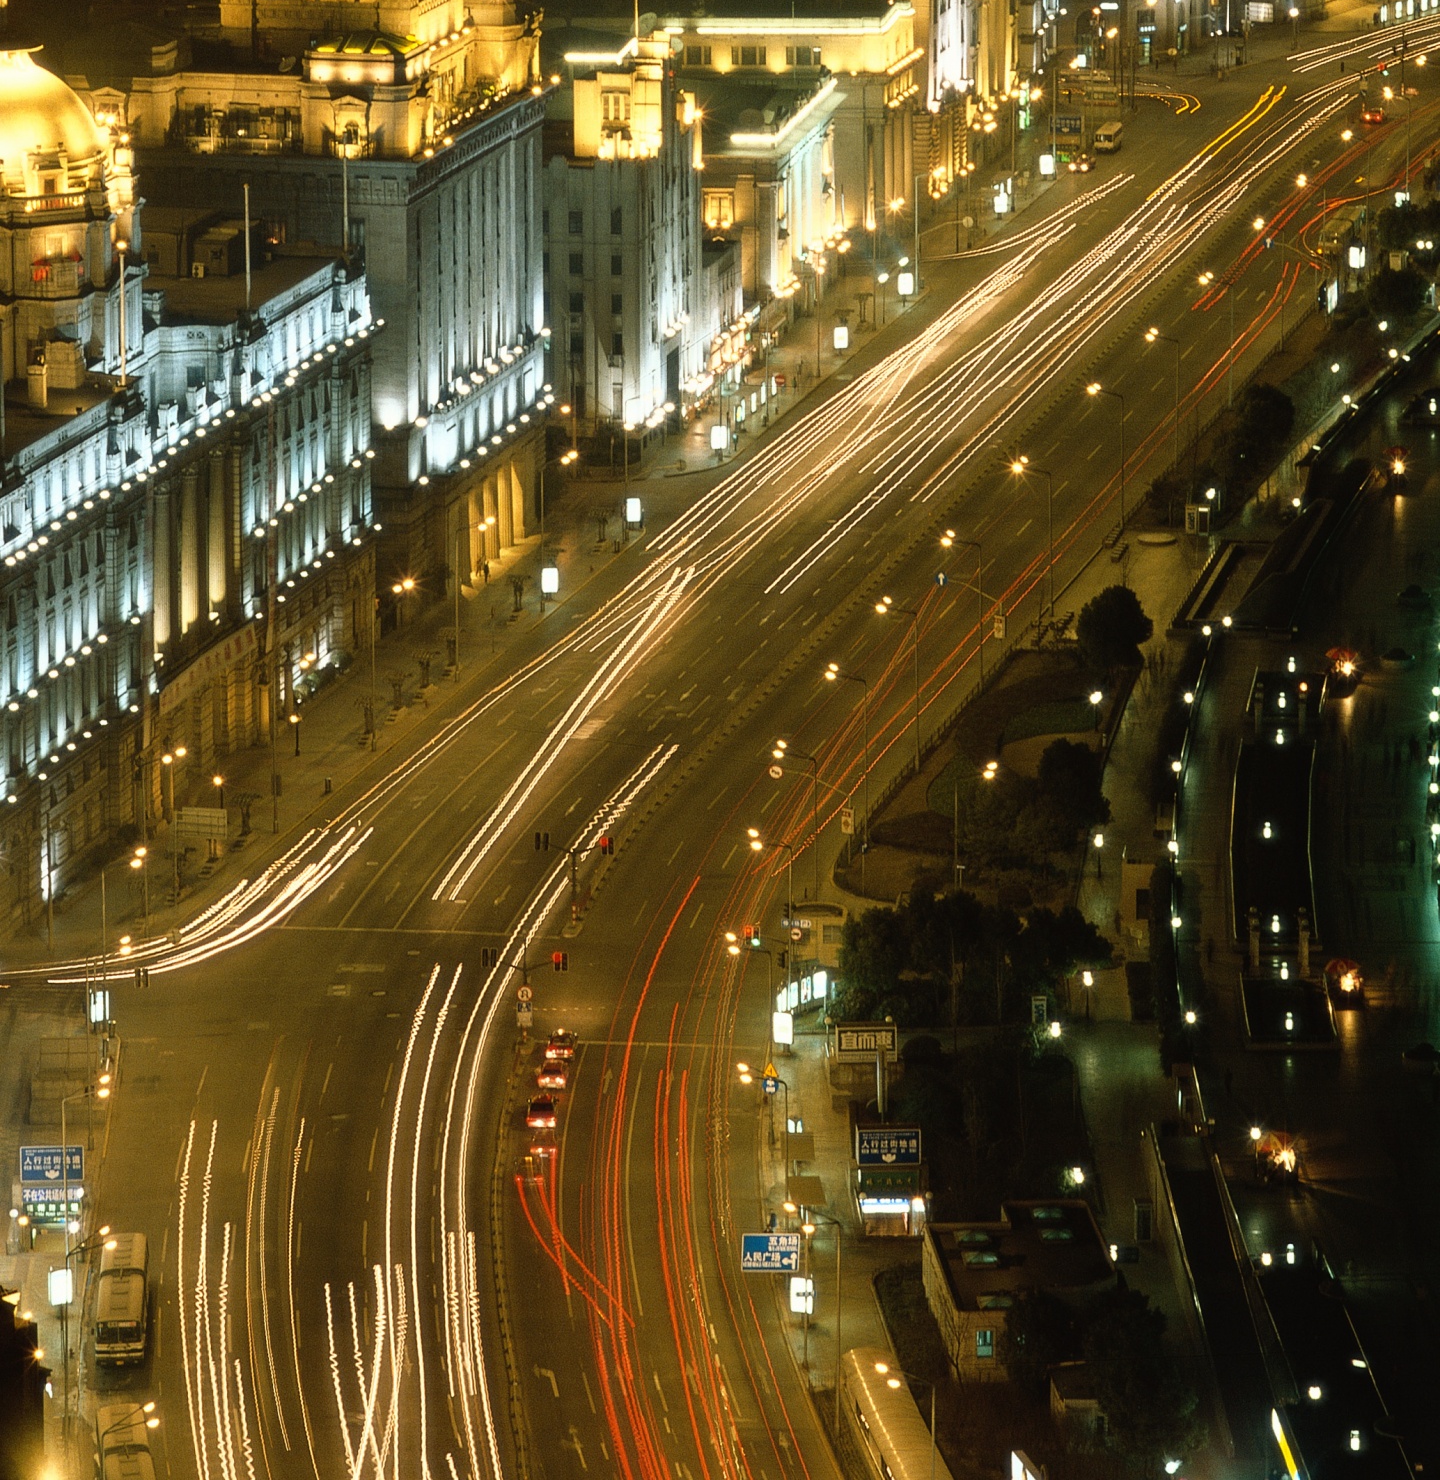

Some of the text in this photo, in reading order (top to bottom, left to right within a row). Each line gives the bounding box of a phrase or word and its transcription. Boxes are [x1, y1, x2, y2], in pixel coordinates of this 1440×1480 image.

[23, 1188, 81, 1202] 不在公共场所
[744, 1251, 781, 1262] 人民广场
